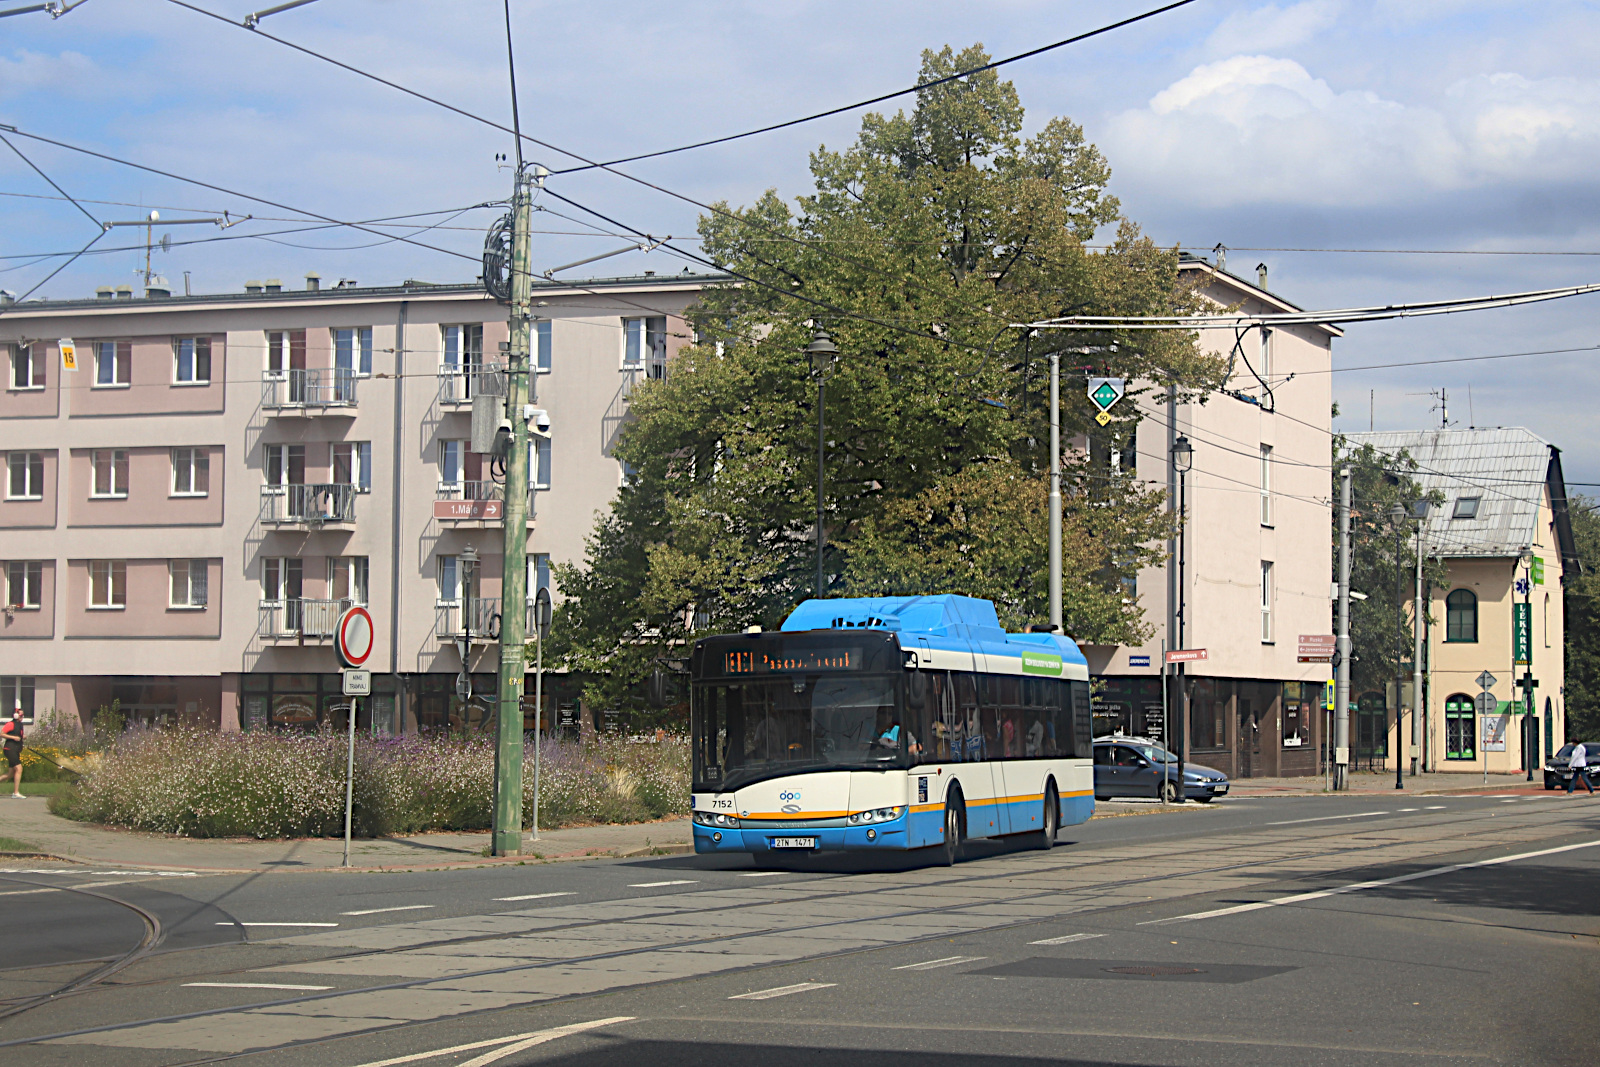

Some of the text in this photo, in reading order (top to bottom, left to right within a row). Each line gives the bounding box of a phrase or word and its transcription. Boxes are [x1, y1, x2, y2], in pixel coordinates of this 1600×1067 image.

[64, 352, 74, 363] 15
[451, 504, 478, 516] 1.Máje
[1170, 652, 1198, 661] Jeremenkova
[712, 800, 732, 808] 7152
[776, 838, 812, 847] 2TN 1471
